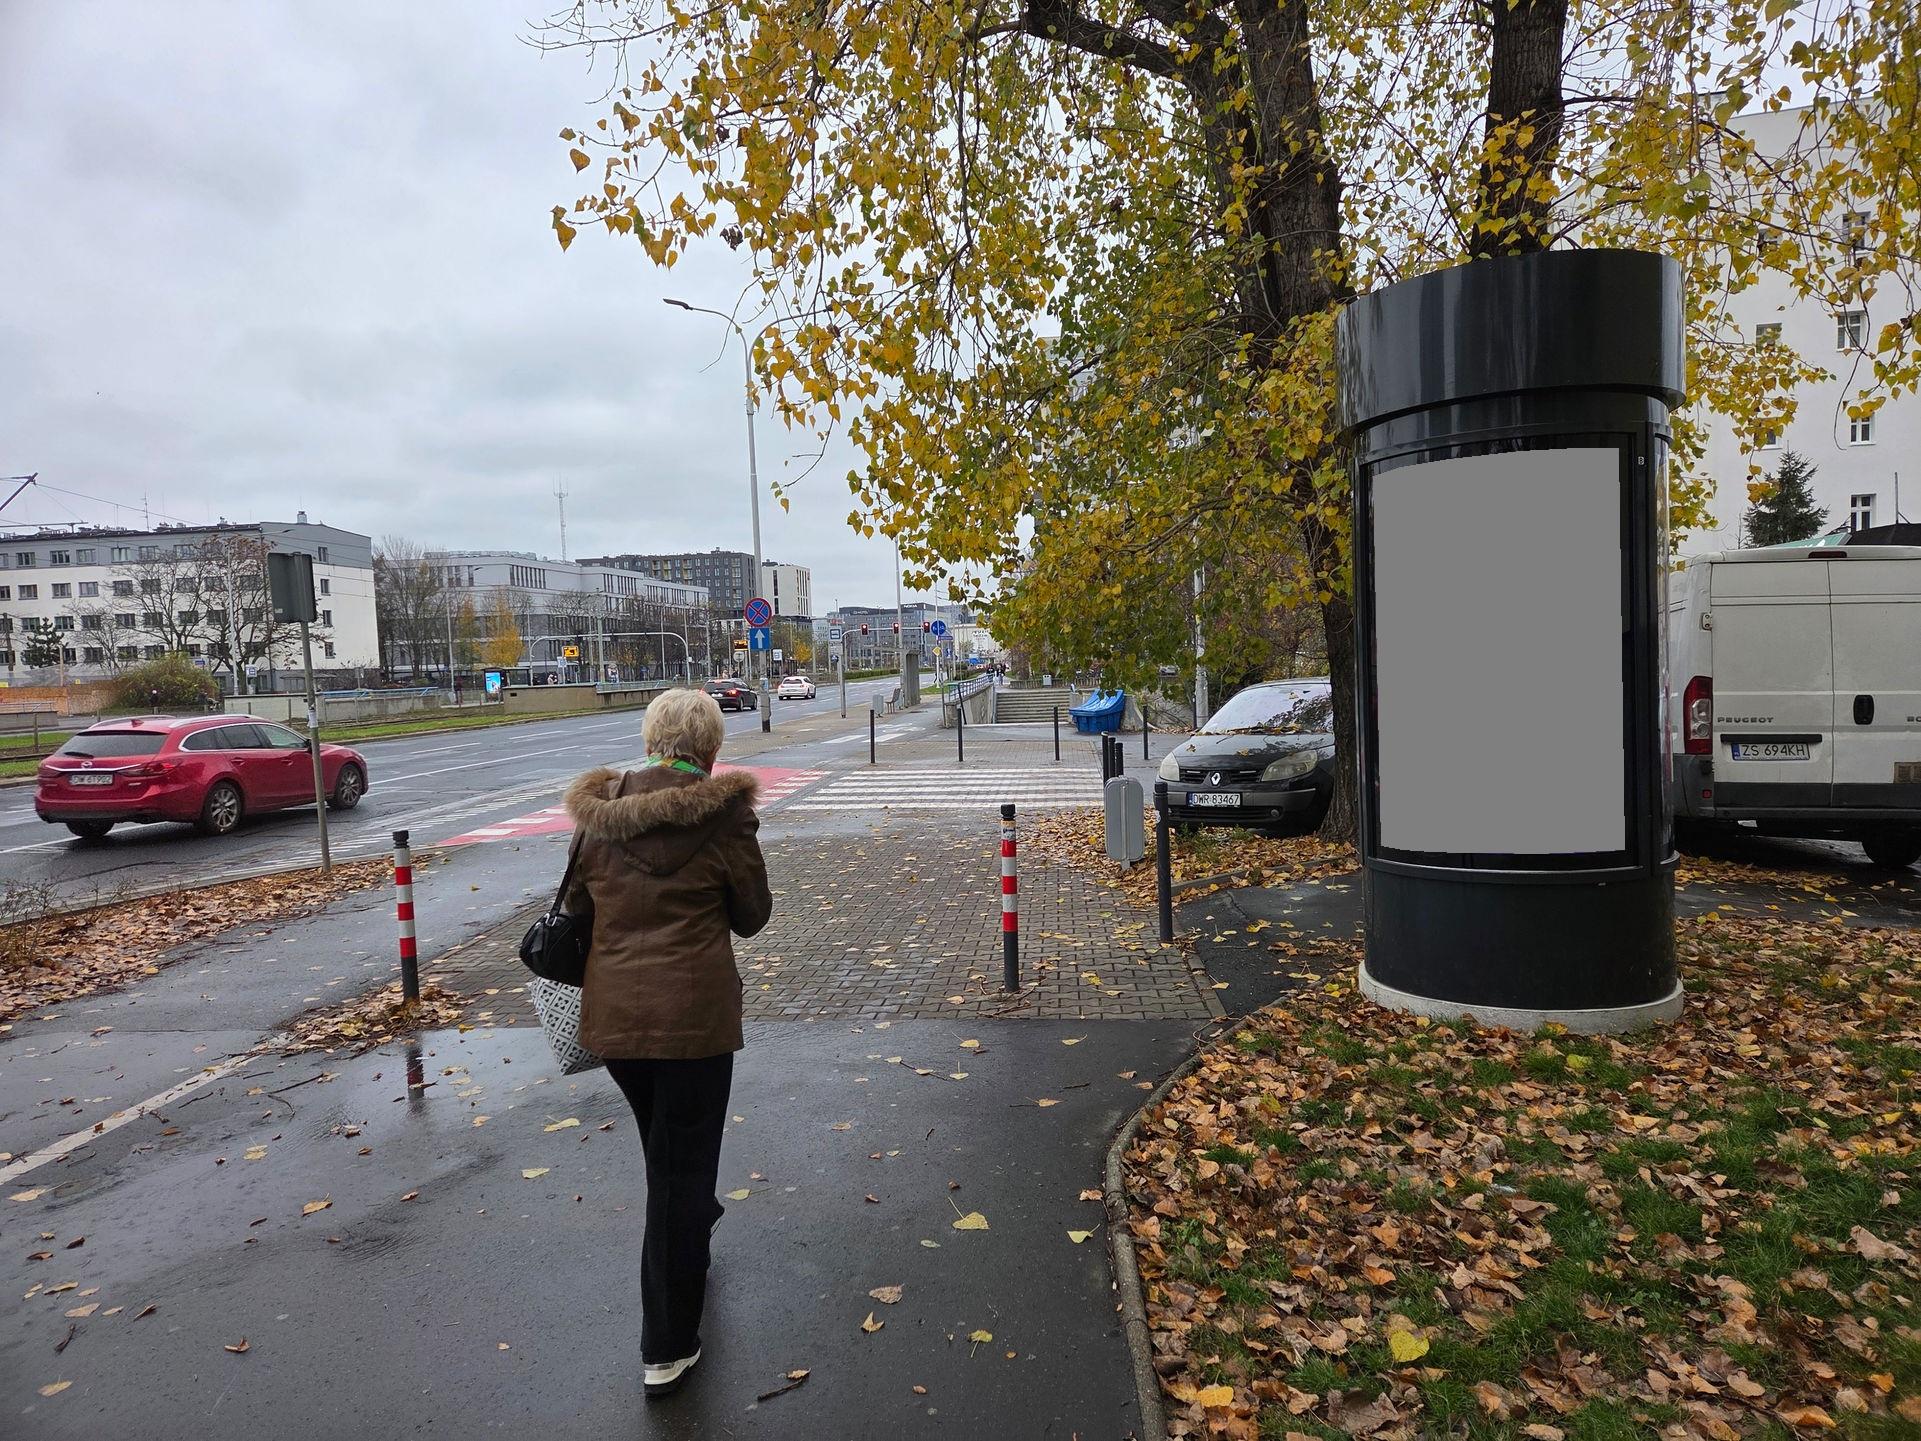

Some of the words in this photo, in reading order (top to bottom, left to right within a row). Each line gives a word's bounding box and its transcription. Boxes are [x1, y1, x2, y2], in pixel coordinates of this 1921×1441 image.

[1742, 744, 1760, 756] ZS
[1764, 744, 1805, 756] 694KH
[1193, 794, 1210, 804] DWR
[1212, 794, 1239, 804] 83467
